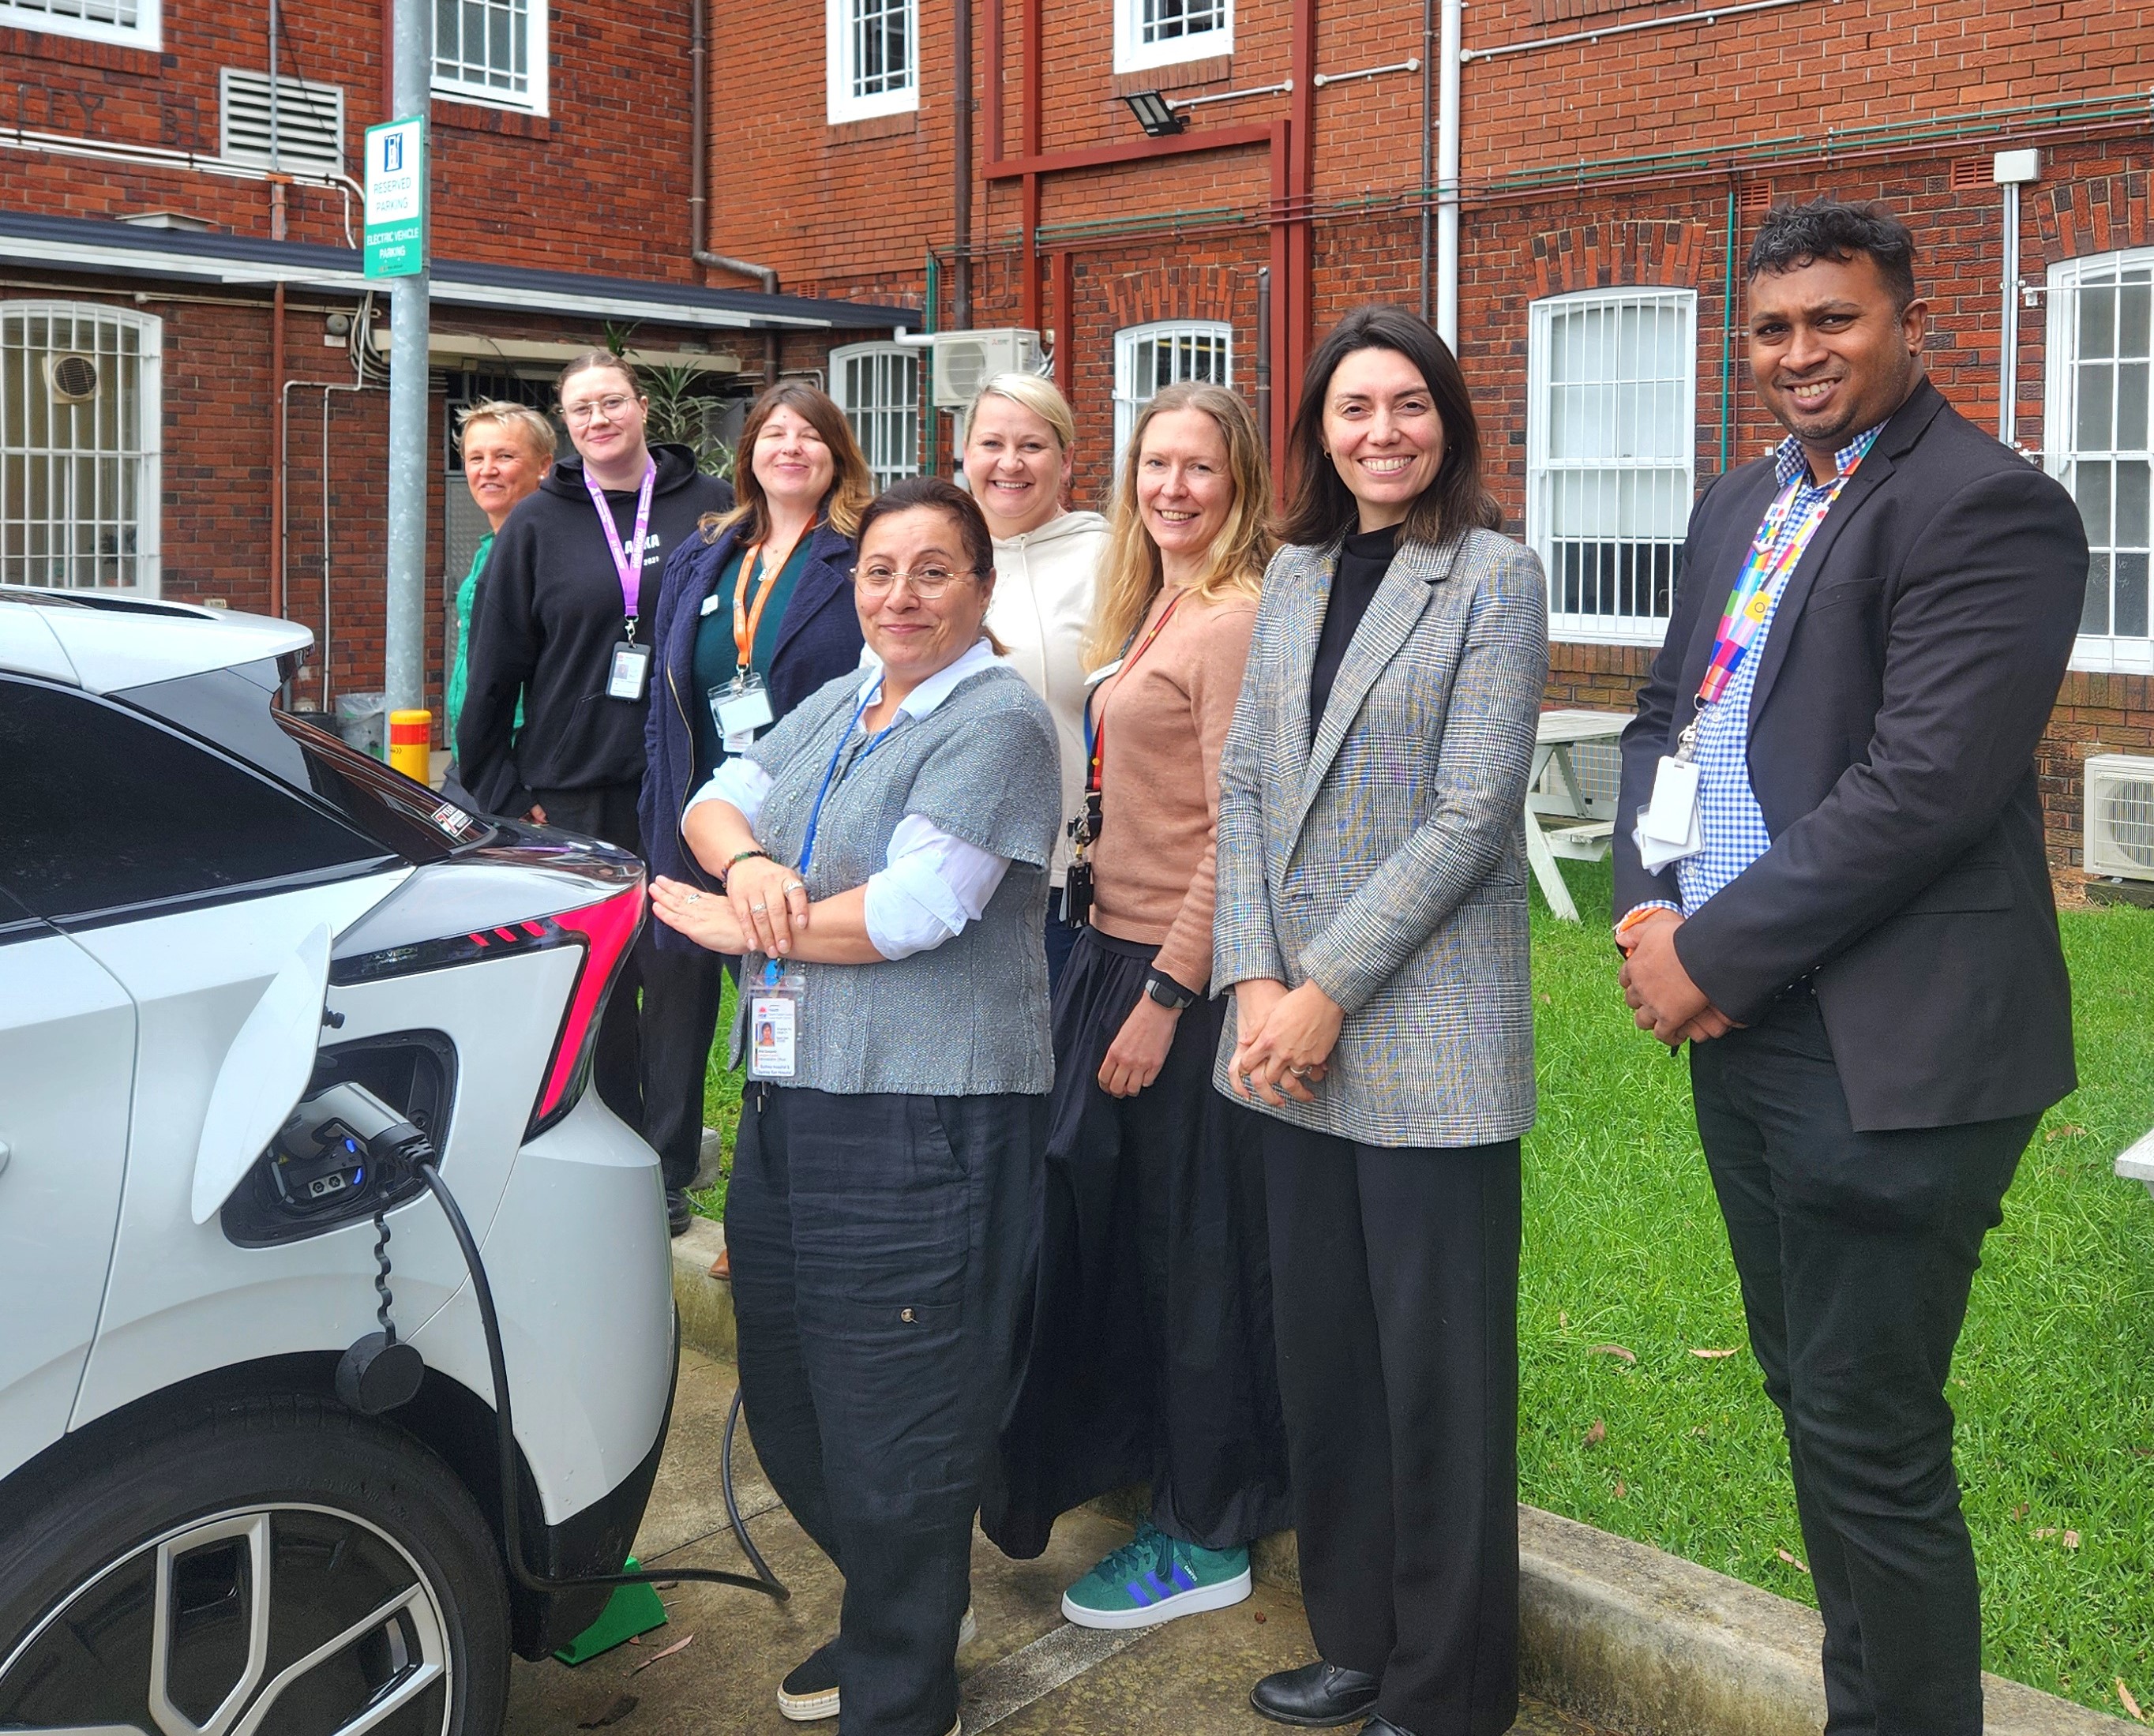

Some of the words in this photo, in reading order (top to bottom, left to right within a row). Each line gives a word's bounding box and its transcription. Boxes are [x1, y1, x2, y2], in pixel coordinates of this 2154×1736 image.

[373, 177, 411, 194] RESERVED
[376, 197, 408, 212] PARKING
[366, 231, 394, 246] ELECTRIC
[395, 227, 419, 242] VEHICLE
[379, 245, 406, 260] PARKING
[625, 534, 660, 554] AKA
[644, 556, 659, 566] 2021
